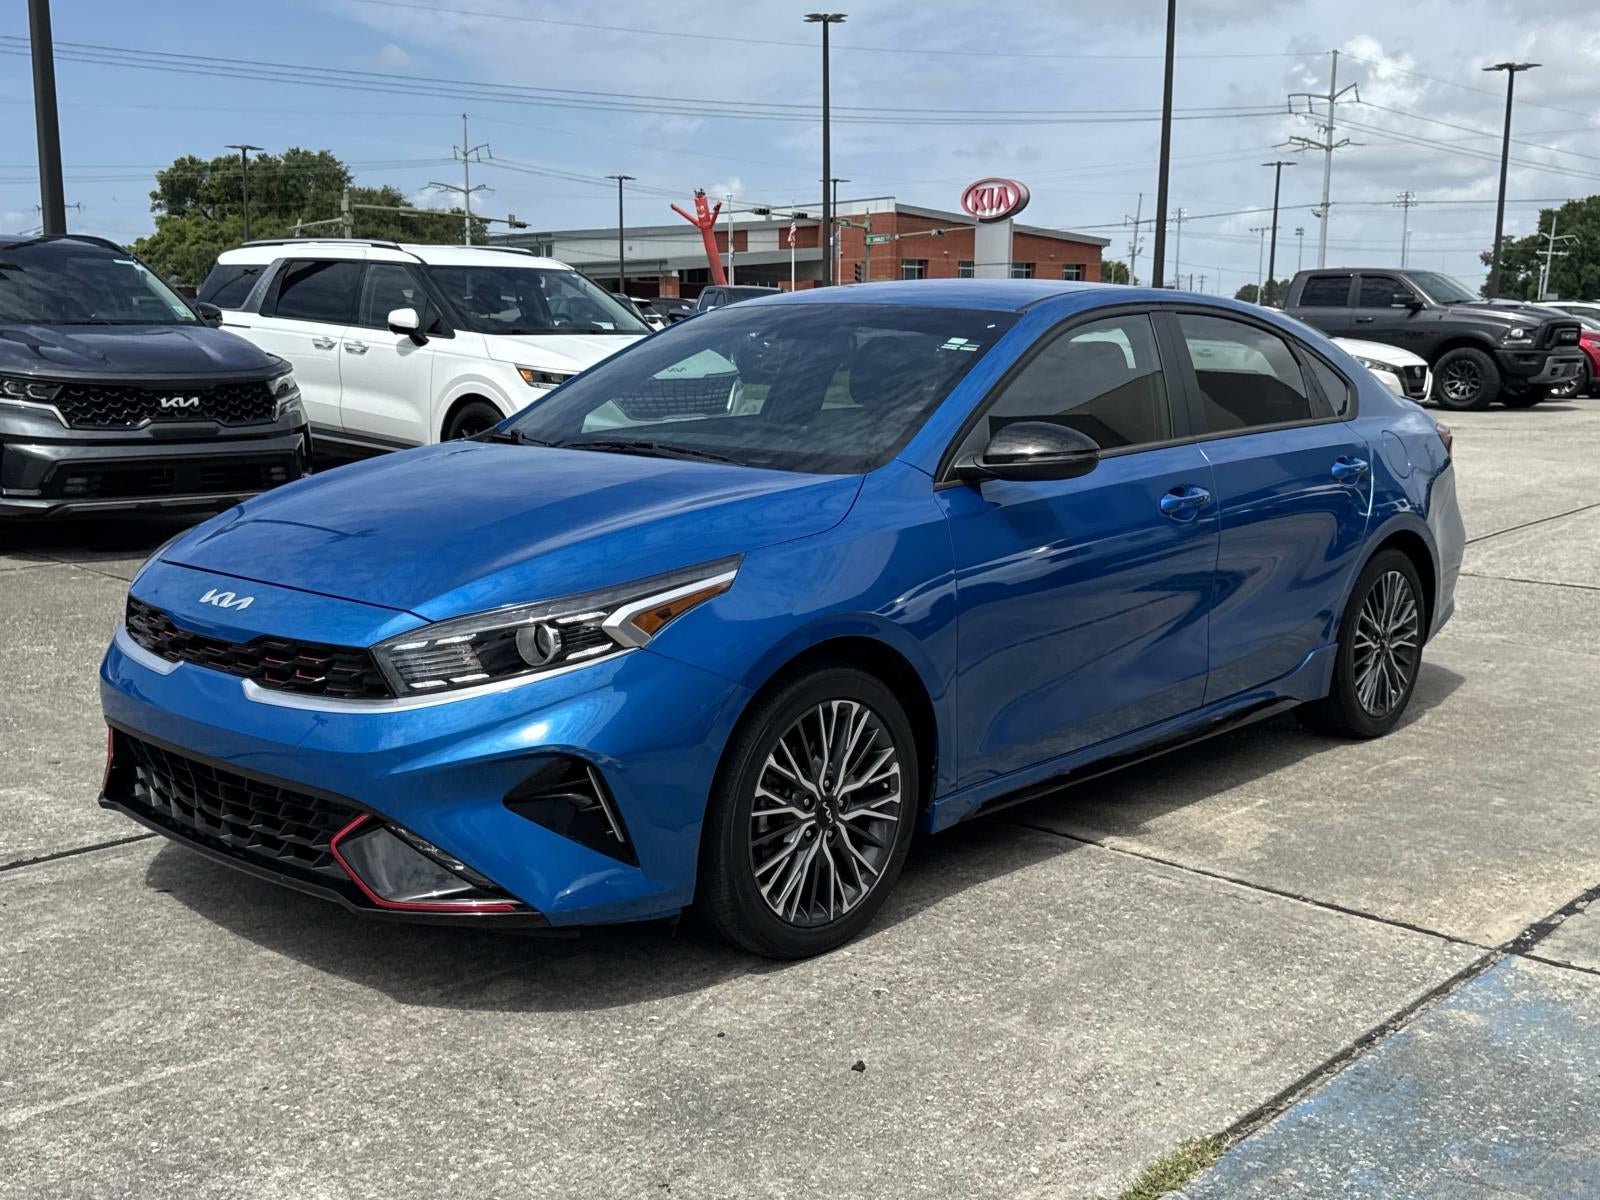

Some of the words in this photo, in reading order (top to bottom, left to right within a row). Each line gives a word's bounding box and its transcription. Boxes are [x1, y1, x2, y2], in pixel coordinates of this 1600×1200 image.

[970, 186, 1010, 211] KIA
[160, 396, 199, 408] KIA
[199, 588, 255, 611] KIA
